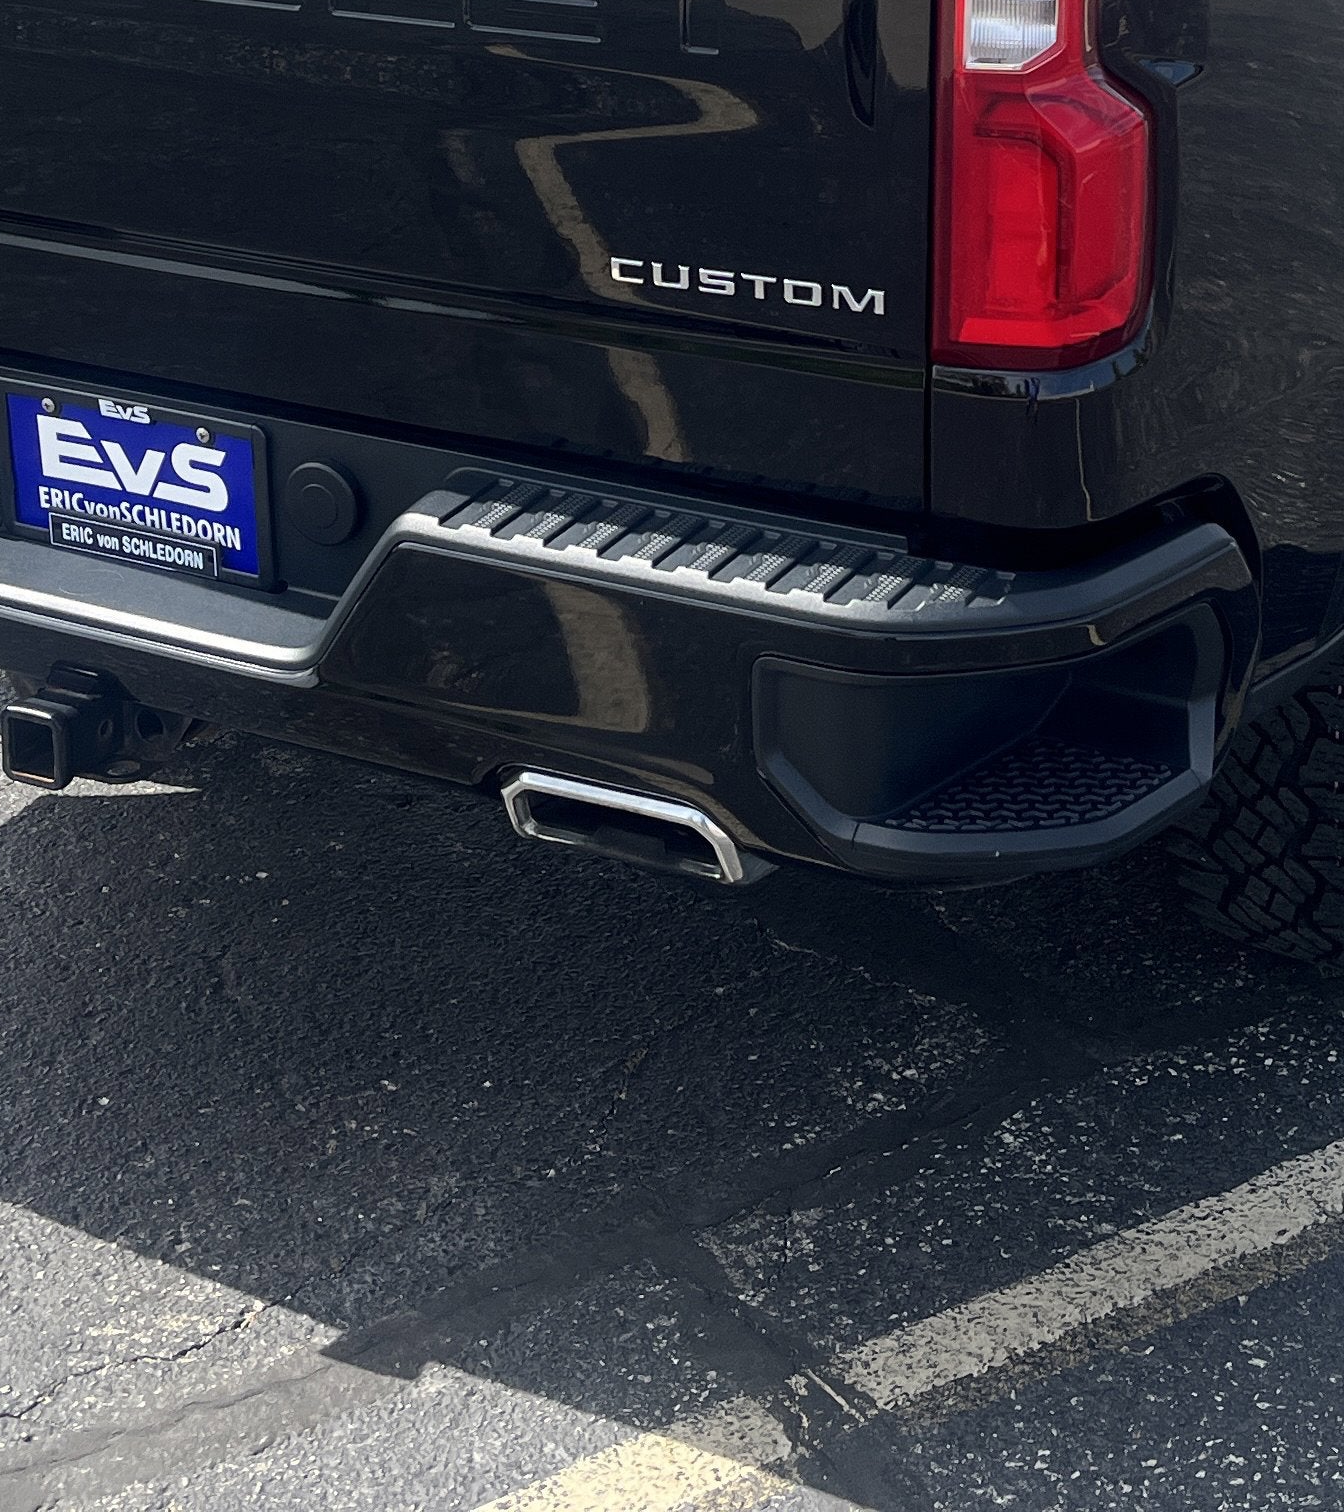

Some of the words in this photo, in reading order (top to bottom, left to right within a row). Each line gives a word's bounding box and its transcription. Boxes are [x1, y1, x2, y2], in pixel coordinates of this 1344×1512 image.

[610, 256, 885, 315] CUSTOM
[61, 522, 93, 545] ERIC
[96, 533, 119, 551] von
[121, 535, 204, 570] SCHLEDORN
